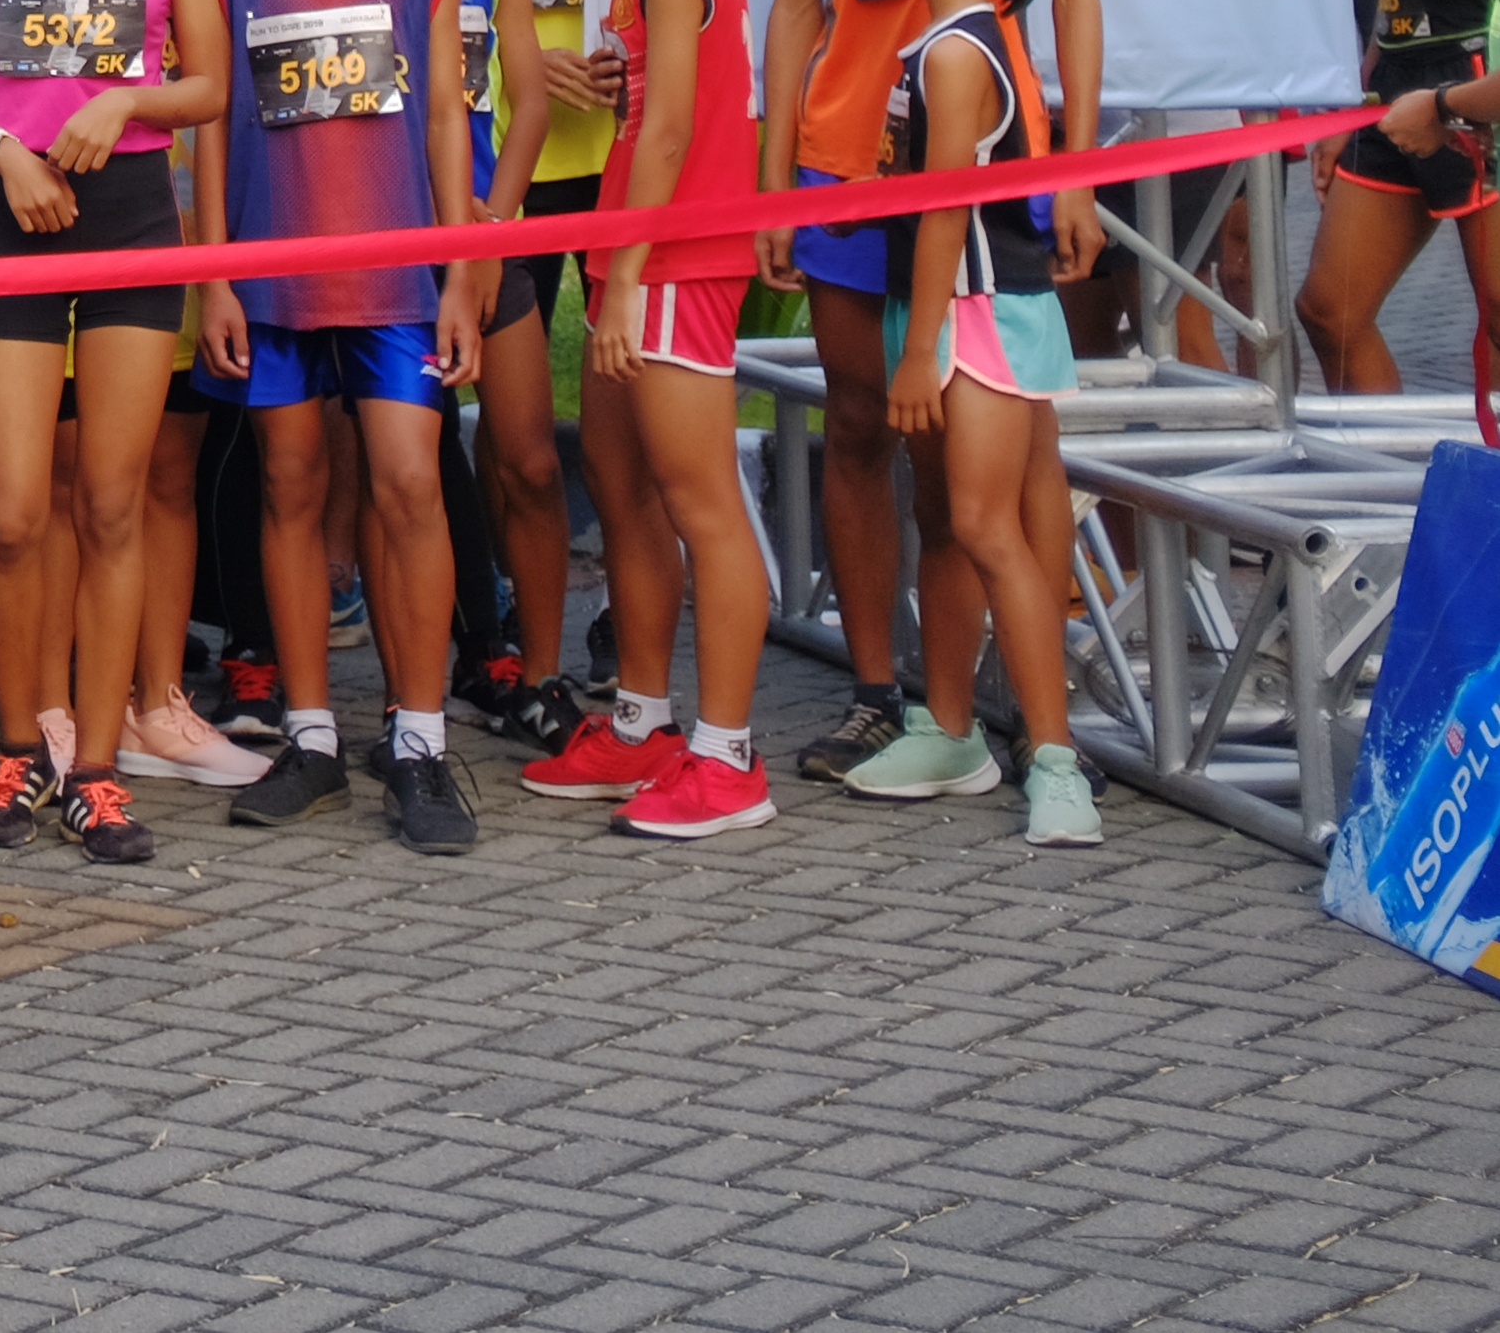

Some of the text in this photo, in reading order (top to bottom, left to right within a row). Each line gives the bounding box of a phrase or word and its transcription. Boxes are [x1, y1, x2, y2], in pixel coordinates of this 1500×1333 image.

[22, 13, 116, 46] 5372
[95, 53, 126, 74] 5K
[279, 52, 366, 94] 5169
[350, 91, 381, 113] 5K
